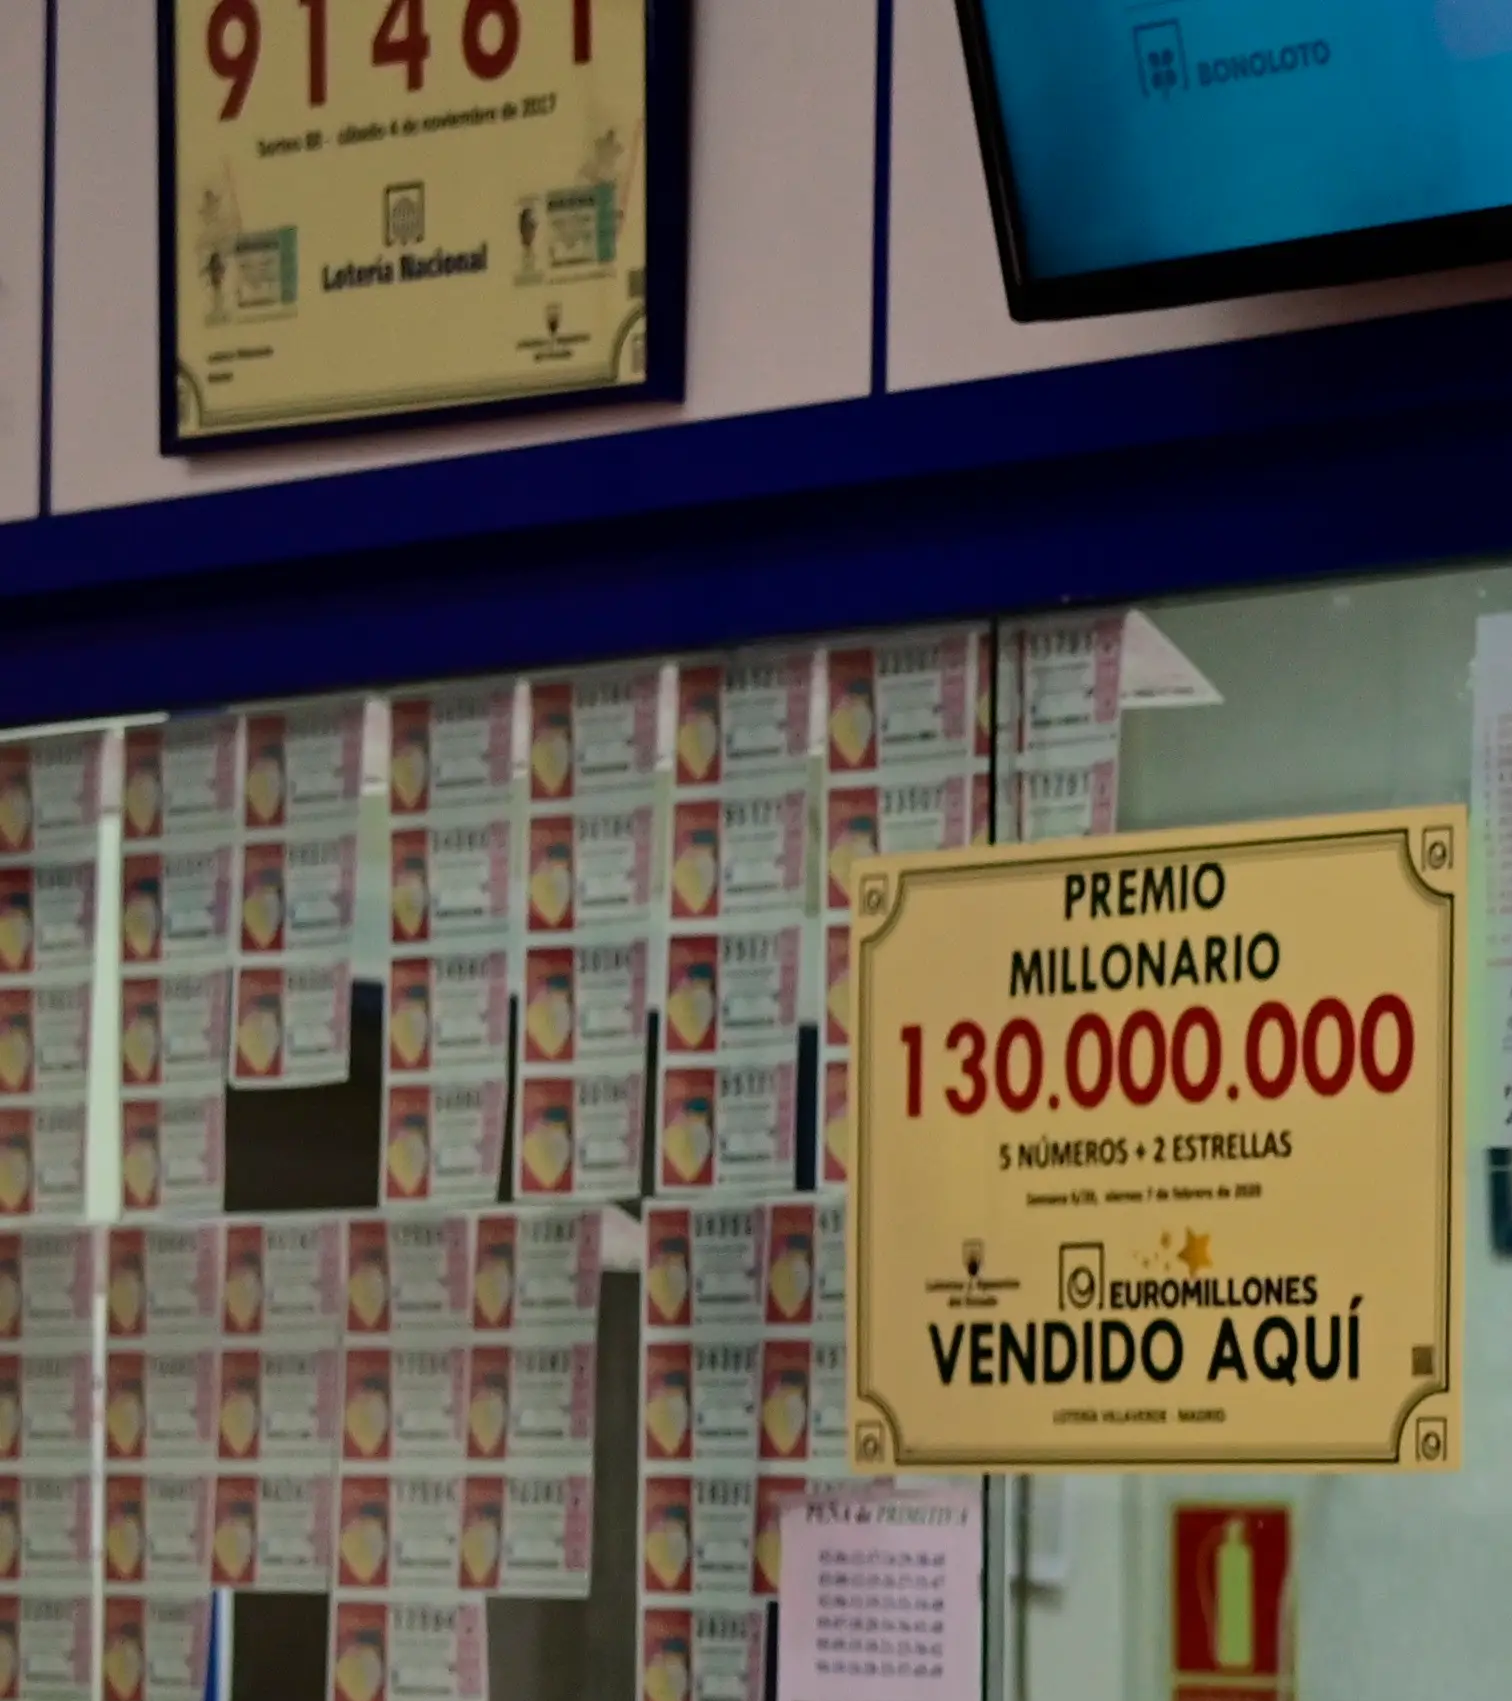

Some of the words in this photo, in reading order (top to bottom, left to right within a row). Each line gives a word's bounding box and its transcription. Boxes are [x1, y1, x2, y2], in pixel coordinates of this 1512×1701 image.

[1197, 39, 1331, 87] BONOLOTO
[1064, 861, 1225, 921] PREMIO
[1009, 932, 1280, 997] MILLONARIO
[900, 993, 1414, 1117] 130.000.000
[1000, 1144, 1010, 1169] 5
[1018, 1135, 1127, 1167] NÚMEROS
[1135, 1146, 1146, 1159] +
[1153, 1136, 1164, 1161] 2
[1172, 1131, 1291, 1162] ESTRELLAS
[1109, 1275, 1316, 1309] EUROMILLONES
[929, 1318, 1183, 1385] VENDIDO
[1208, 1295, 1362, 1385] AQUÍ
